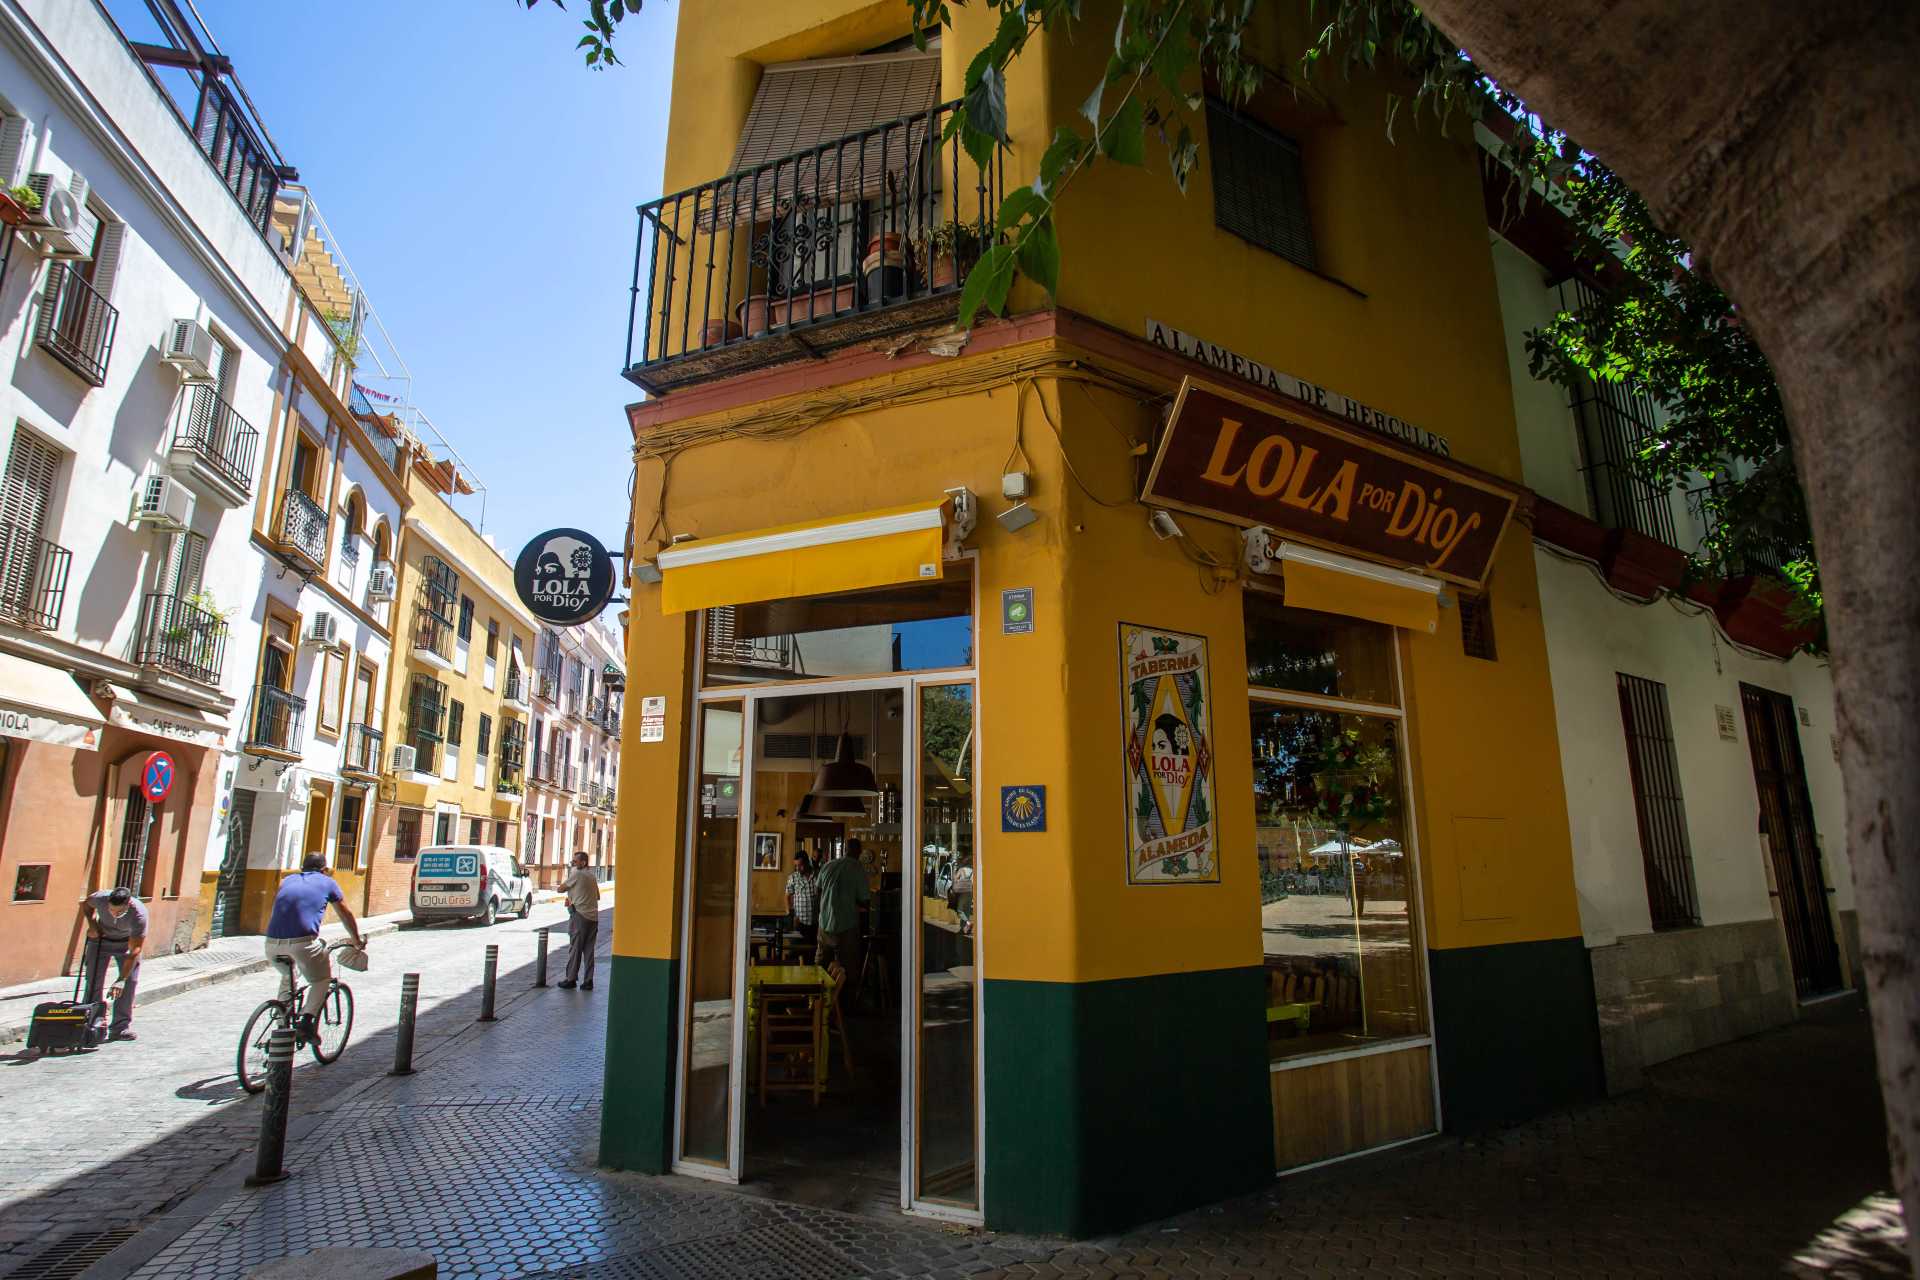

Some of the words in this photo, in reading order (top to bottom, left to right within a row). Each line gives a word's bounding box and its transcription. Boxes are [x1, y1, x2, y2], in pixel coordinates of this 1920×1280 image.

[1151, 323, 1281, 390] ALAMEDA
[1299, 381, 1328, 408] DE
[1344, 399, 1450, 457] HERCULES
[1201, 417, 1359, 521] LOLA
[1359, 482, 1396, 512] POR
[532, 579, 591, 595] LOLA
[534, 594, 552, 602] POR
[1131, 653, 1200, 680] TABERNA
[0, 713, 29, 732] IOLA
[1151, 755, 1191, 772] LOLA
[1139, 826, 1209, 866] ALAMEDA
